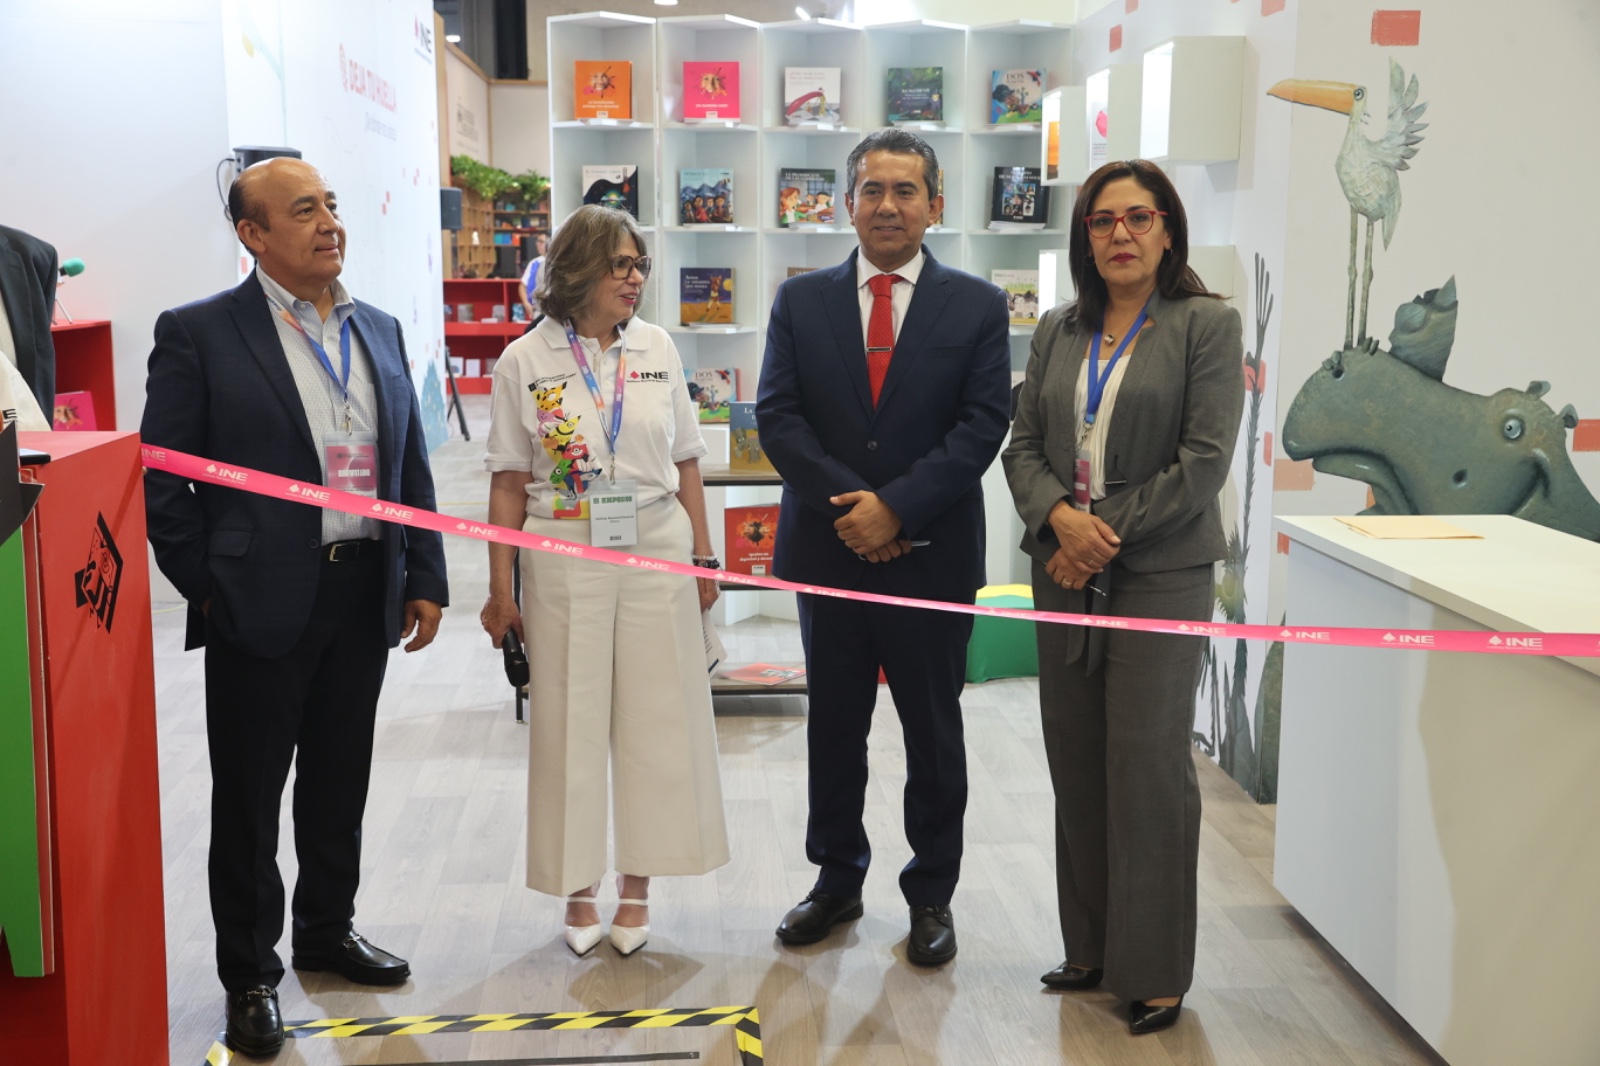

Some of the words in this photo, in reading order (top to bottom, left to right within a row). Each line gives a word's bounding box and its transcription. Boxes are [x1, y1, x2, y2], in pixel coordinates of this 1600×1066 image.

[641, 371, 669, 380] INE
[142, 450, 166, 462] INE
[219, 468, 249, 481] INE
[301, 487, 331, 501] INE
[385, 506, 414, 518] INE
[469, 526, 499, 538] INE
[554, 544, 584, 555] INE
[640, 561, 671, 571] INE
[727, 575, 758, 585] INE
[1096, 619, 1128, 627] INE
[1193, 626, 1226, 635] INE
[1295, 631, 1331, 640] INE
[1399, 635, 1435, 645] INE
[1506, 637, 1543, 647] INE
